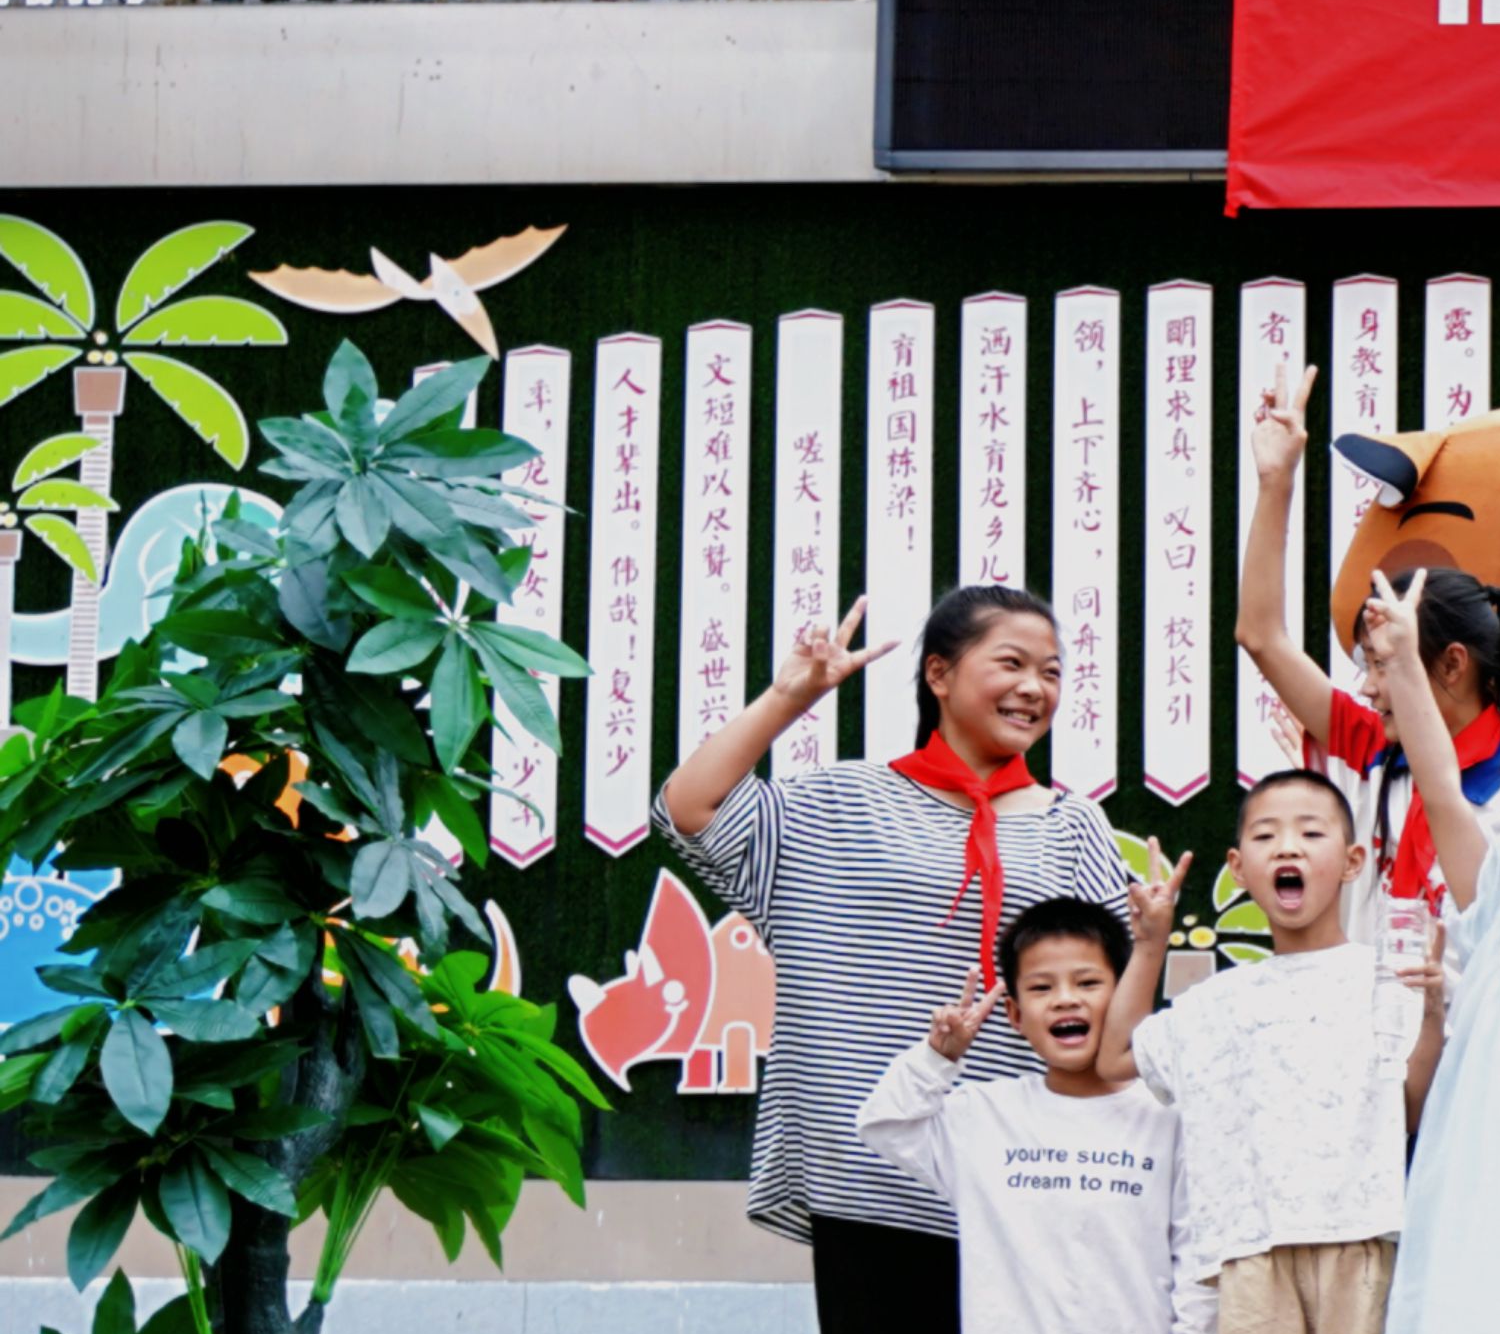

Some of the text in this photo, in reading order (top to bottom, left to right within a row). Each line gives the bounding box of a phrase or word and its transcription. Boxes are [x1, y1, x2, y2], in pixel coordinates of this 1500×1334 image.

[1005, 1148, 1154, 1171] you're such a
[1007, 1172, 1143, 1197] dream to me
